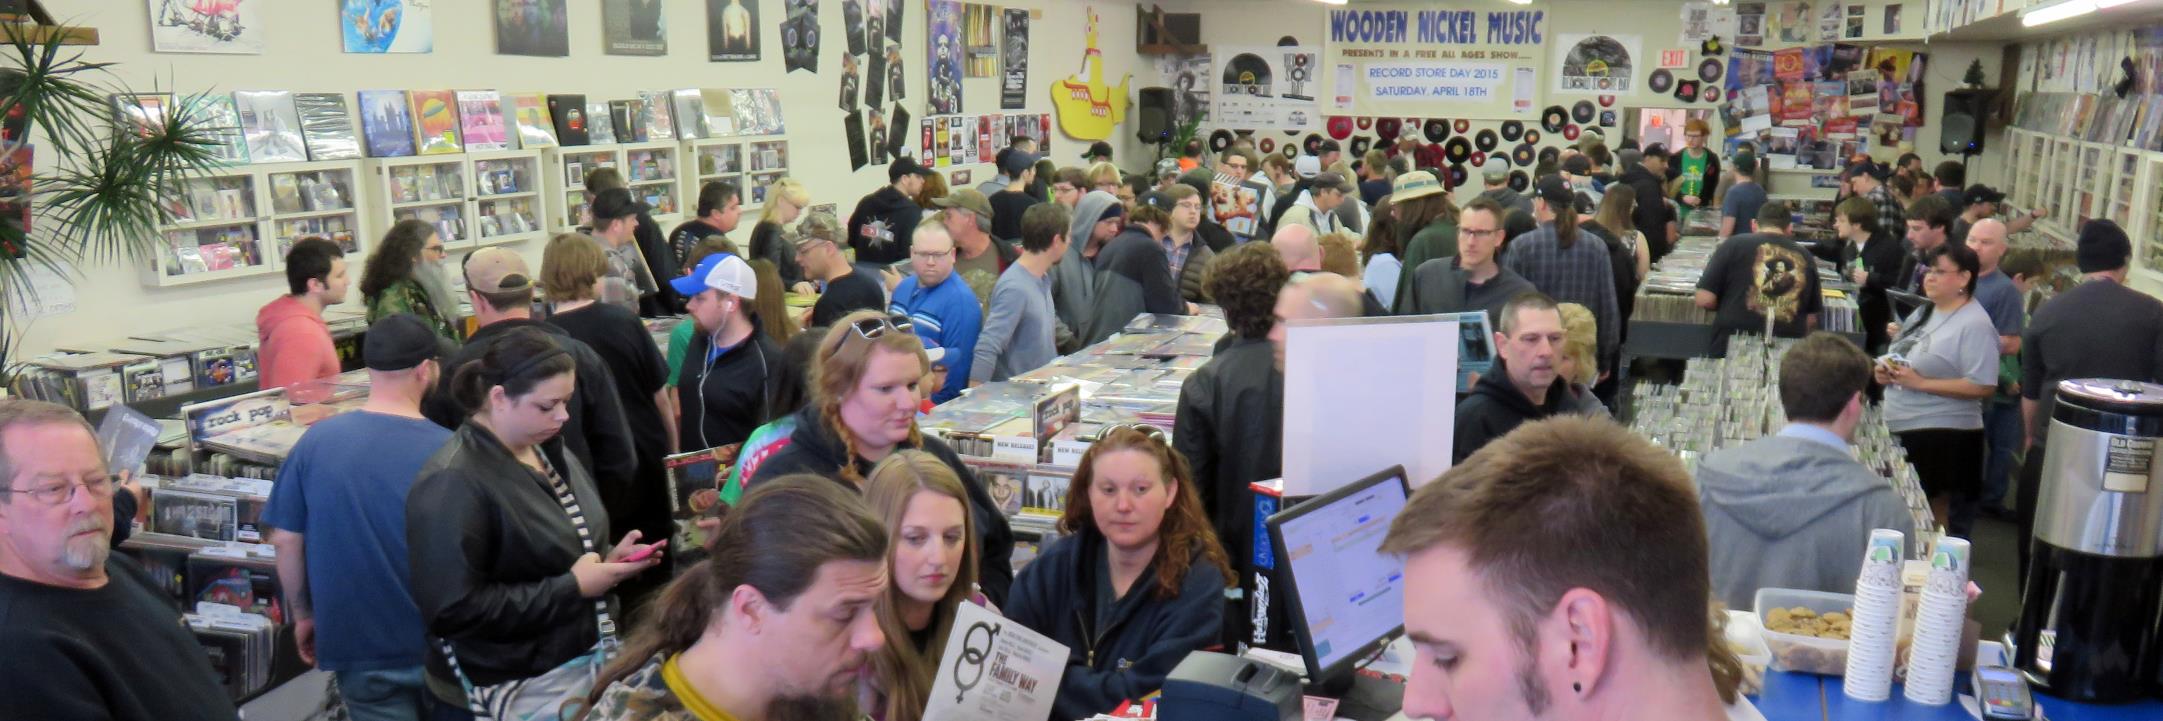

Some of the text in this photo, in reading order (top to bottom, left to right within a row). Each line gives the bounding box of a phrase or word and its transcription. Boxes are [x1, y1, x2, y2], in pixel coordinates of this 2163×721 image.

[1330, 9, 1544, 45] WOODEN NICKEL MUSIC
[1342, 49, 1385, 58] PRESENTS
[1389, 49, 1399, 58] IN
[1403, 50, 1410, 58] A
[1415, 50, 1437, 58] FREE
[1441, 50, 1456, 59] ALL
[1461, 51, 1486, 59] AGES
[1663, 48, 1684, 66] EXIT
[1369, 67, 1499, 79] RECORD STORE DAY 2015
[1432, 87, 1460, 97] APRIL
[1464, 87, 1488, 97] 18TH
[207, 404, 274, 428] rock pop
[994, 651, 1008, 665] THE
[989, 662, 1019, 685] FAMILY
[1018, 672, 1038, 694] WAY
